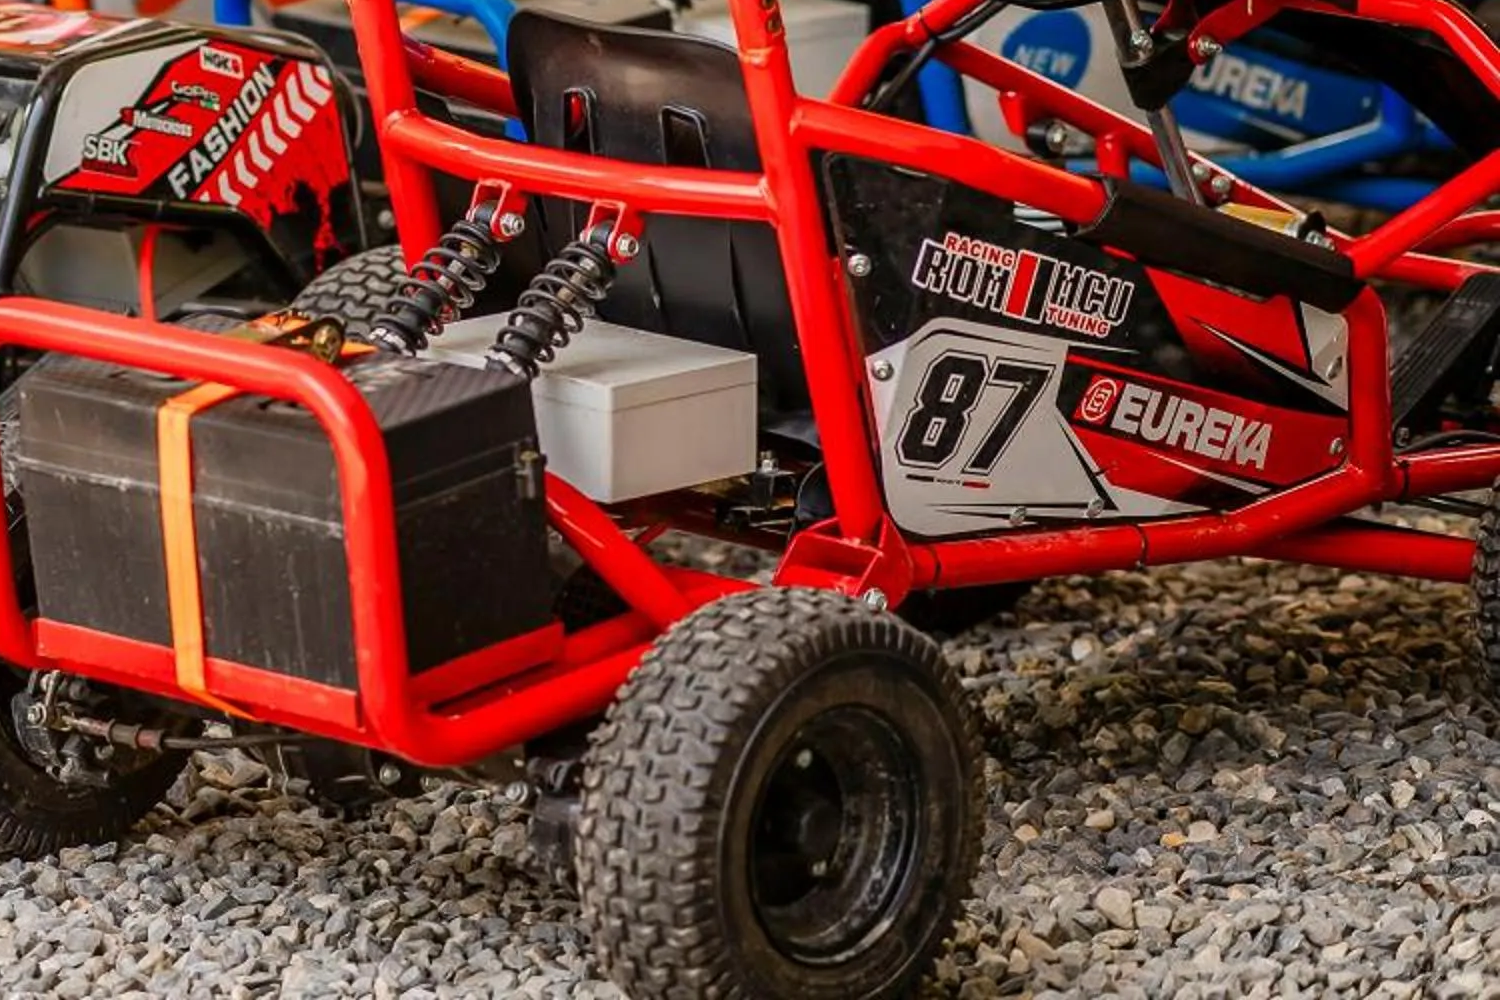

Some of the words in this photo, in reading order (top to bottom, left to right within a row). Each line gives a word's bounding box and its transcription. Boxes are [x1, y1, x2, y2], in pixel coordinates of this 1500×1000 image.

[1013, 45, 1078, 78] NEW
[1190, 50, 1309, 119] UREKA
[83, 134, 129, 166] SBK
[167, 62, 276, 200] FASHION
[944, 232, 1016, 268] RACING
[1046, 305, 1111, 338] TUNING
[894, 349, 1057, 476] 87
[1111, 382, 1273, 471] EUREKA
